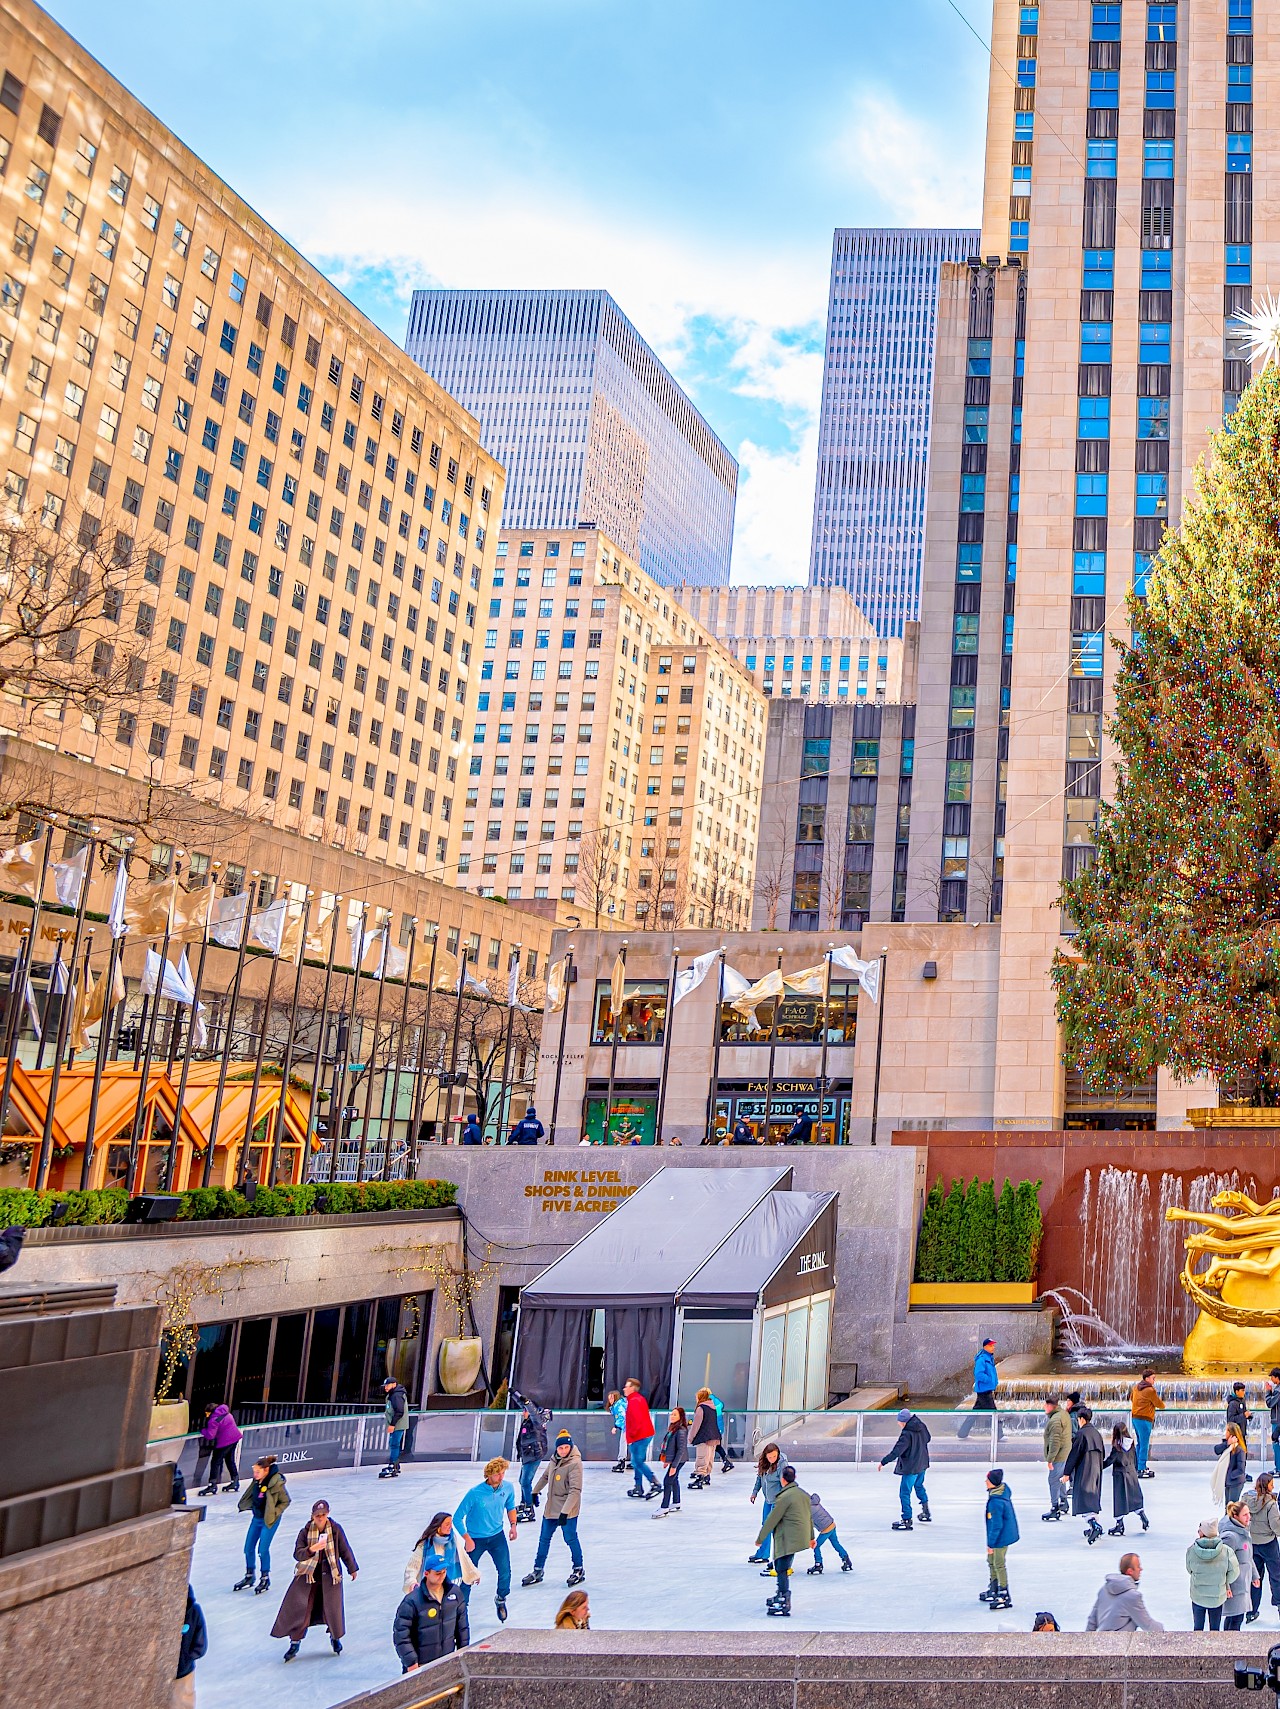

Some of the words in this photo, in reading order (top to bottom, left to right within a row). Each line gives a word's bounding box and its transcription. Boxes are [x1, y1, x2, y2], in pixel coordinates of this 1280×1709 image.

[8, 919, 30, 935] NB
[776, 1082, 815, 1092] SCHWA
[543, 1170, 578, 1182] RINK
[581, 1170, 621, 1182] LEVEL
[524, 1185, 571, 1197] SHOPS
[573, 1185, 583, 1197] &
[542, 1200, 571, 1212] FIVE
[574, 1200, 618, 1212] ACRES
[800, 1254, 811, 1272] THE
[811, 1251, 826, 1269] RINK
[282, 1450, 308, 1462] RINK
